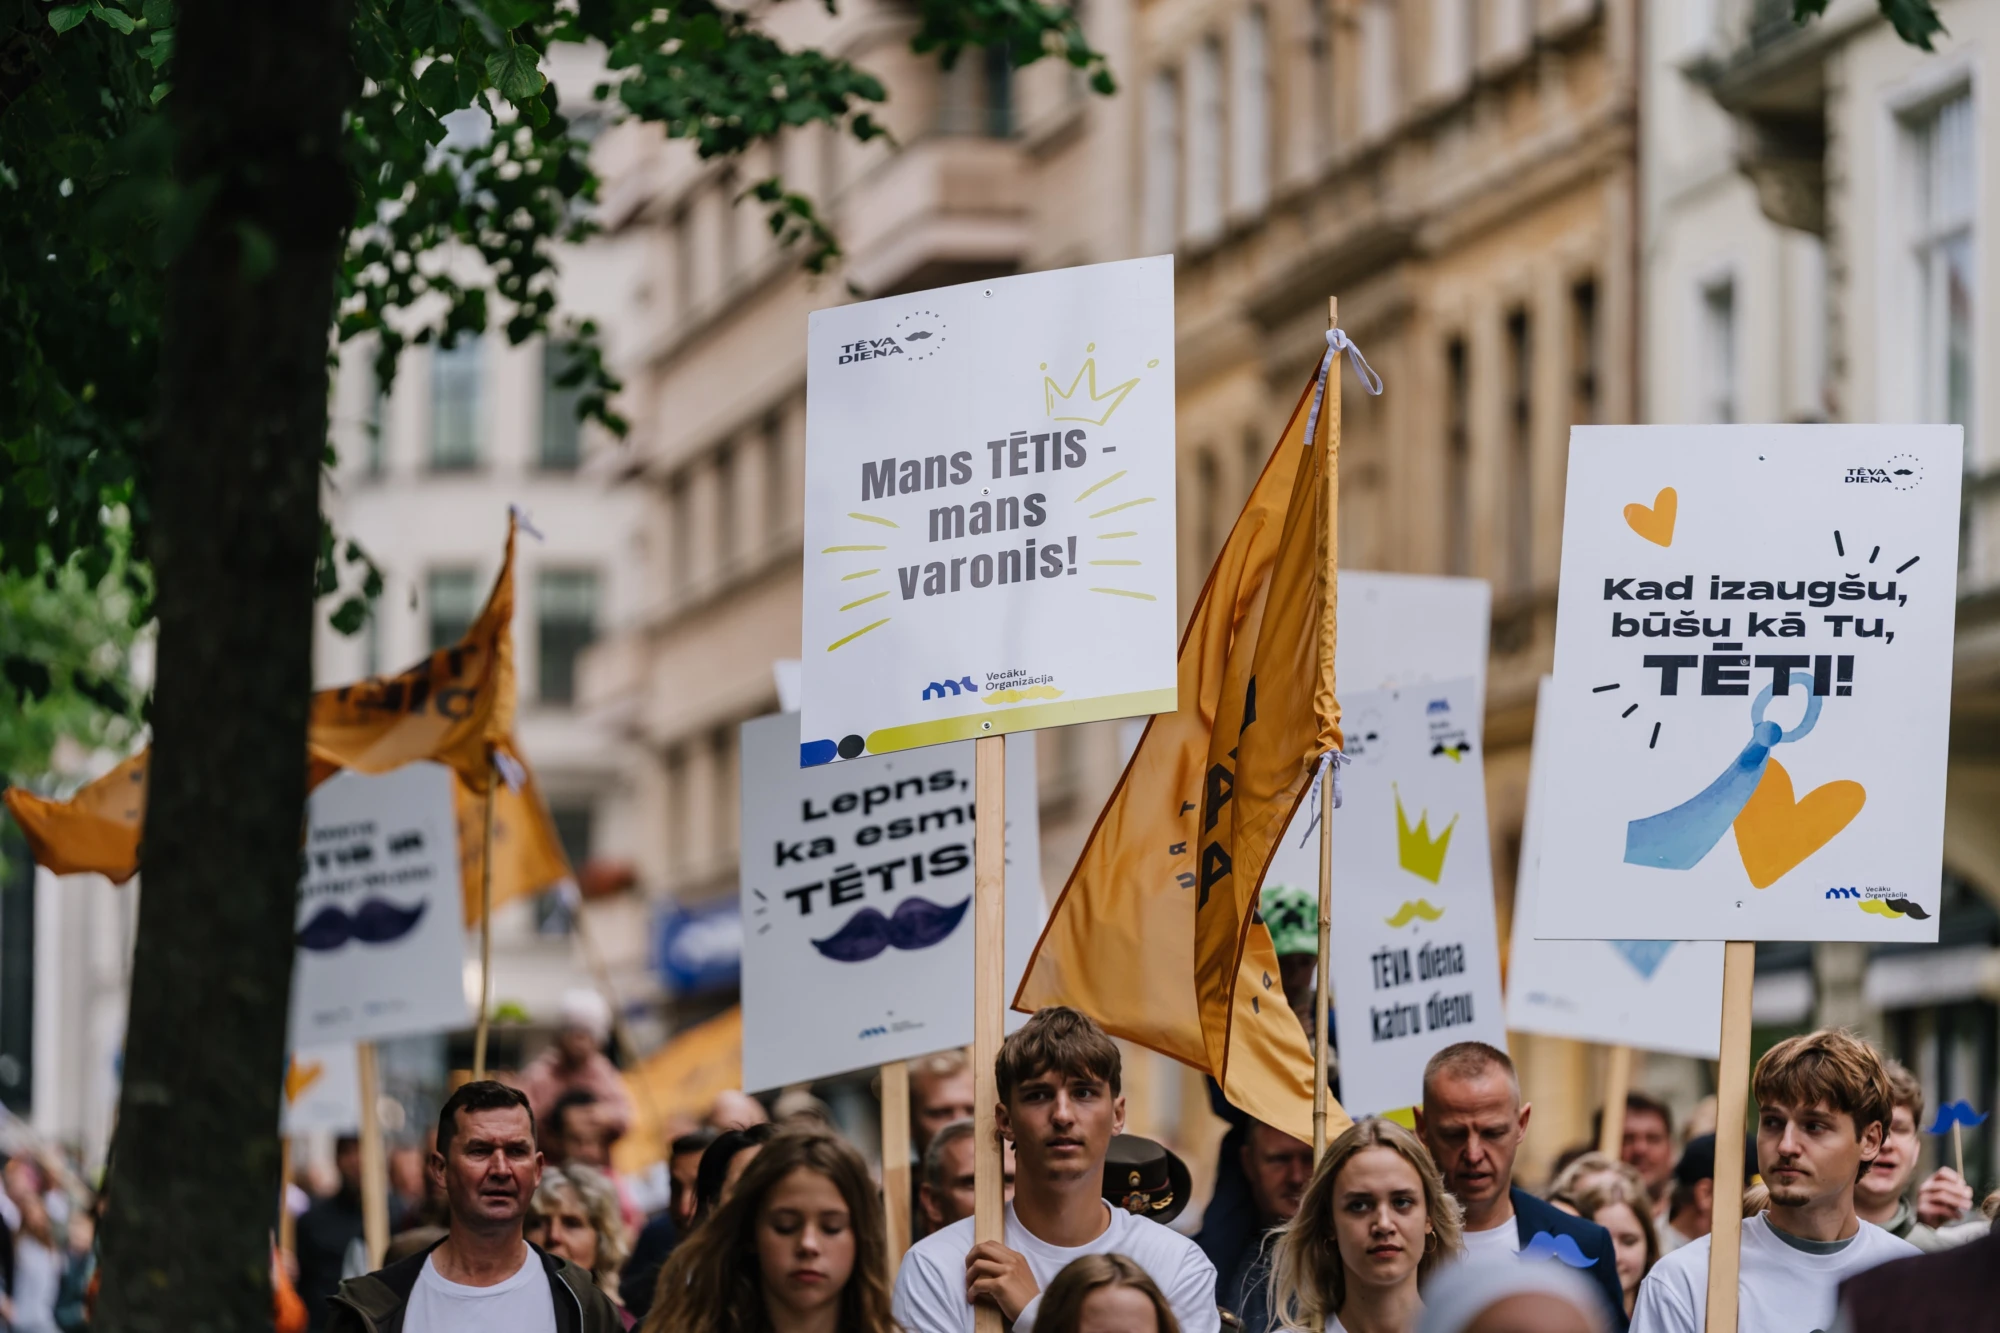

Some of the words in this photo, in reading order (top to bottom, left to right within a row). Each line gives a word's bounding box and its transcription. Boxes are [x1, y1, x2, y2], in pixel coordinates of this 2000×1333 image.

[838, 345, 904, 365] DIENA
[841, 336, 897, 354] TĒVA
[861, 450, 973, 501] Mans
[987, 428, 1087, 480] TĒTIS
[1844, 476, 1892, 484] DIENA
[1846, 467, 1887, 476] TĒVA
[929, 492, 1047, 543] mans
[898, 535, 1077, 600] varonis!
[1603, 575, 1694, 601] Kad
[1710, 572, 1908, 608] izaugšu,
[1611, 609, 1731, 638] būšu
[1748, 611, 1806, 638] kā
[1823, 614, 1895, 645] Tu,
[985, 674, 1054, 691] Organizācija
[986, 669, 1027, 681] Vecāku
[1642, 642, 1855, 697] TĒTI!
[803, 768, 969, 822] Lepns,
[774, 834, 837, 867] ka
[854, 802, 976, 847] esm
[784, 838, 976, 916] TĒTIS
[1865, 891, 1908, 900] Organizācija
[1371, 944, 1413, 990] TĒVA
[1417, 939, 1466, 982] diena
[1370, 1001, 1422, 1043] katru
[1426, 989, 1475, 1031] dienu
